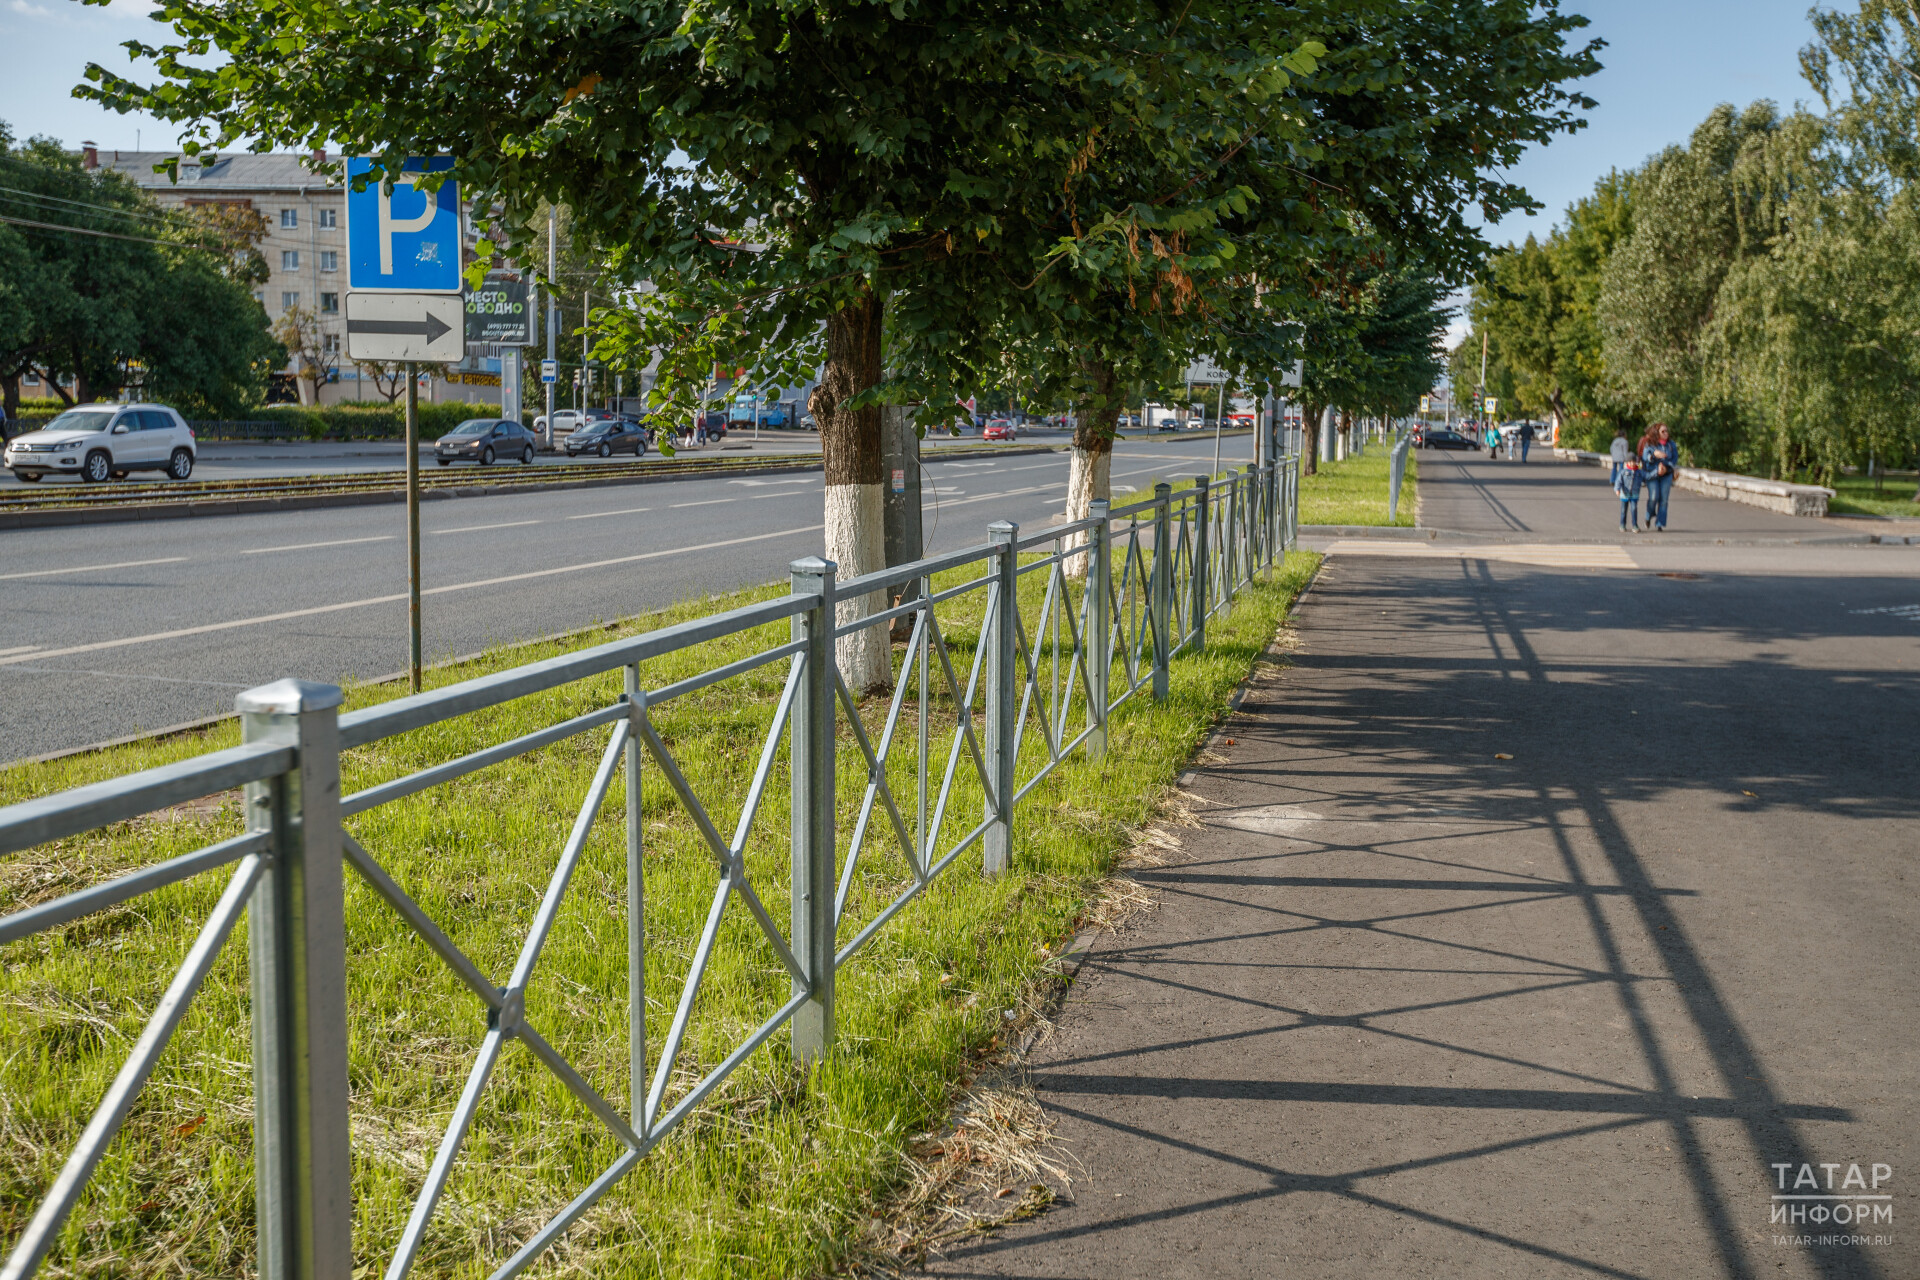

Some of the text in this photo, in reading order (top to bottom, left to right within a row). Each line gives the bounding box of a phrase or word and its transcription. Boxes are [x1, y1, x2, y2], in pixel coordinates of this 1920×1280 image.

[378, 171, 438, 275] P
[465, 291, 508, 303] МЕСТО
[466, 302, 523, 315] ОБОДНО
